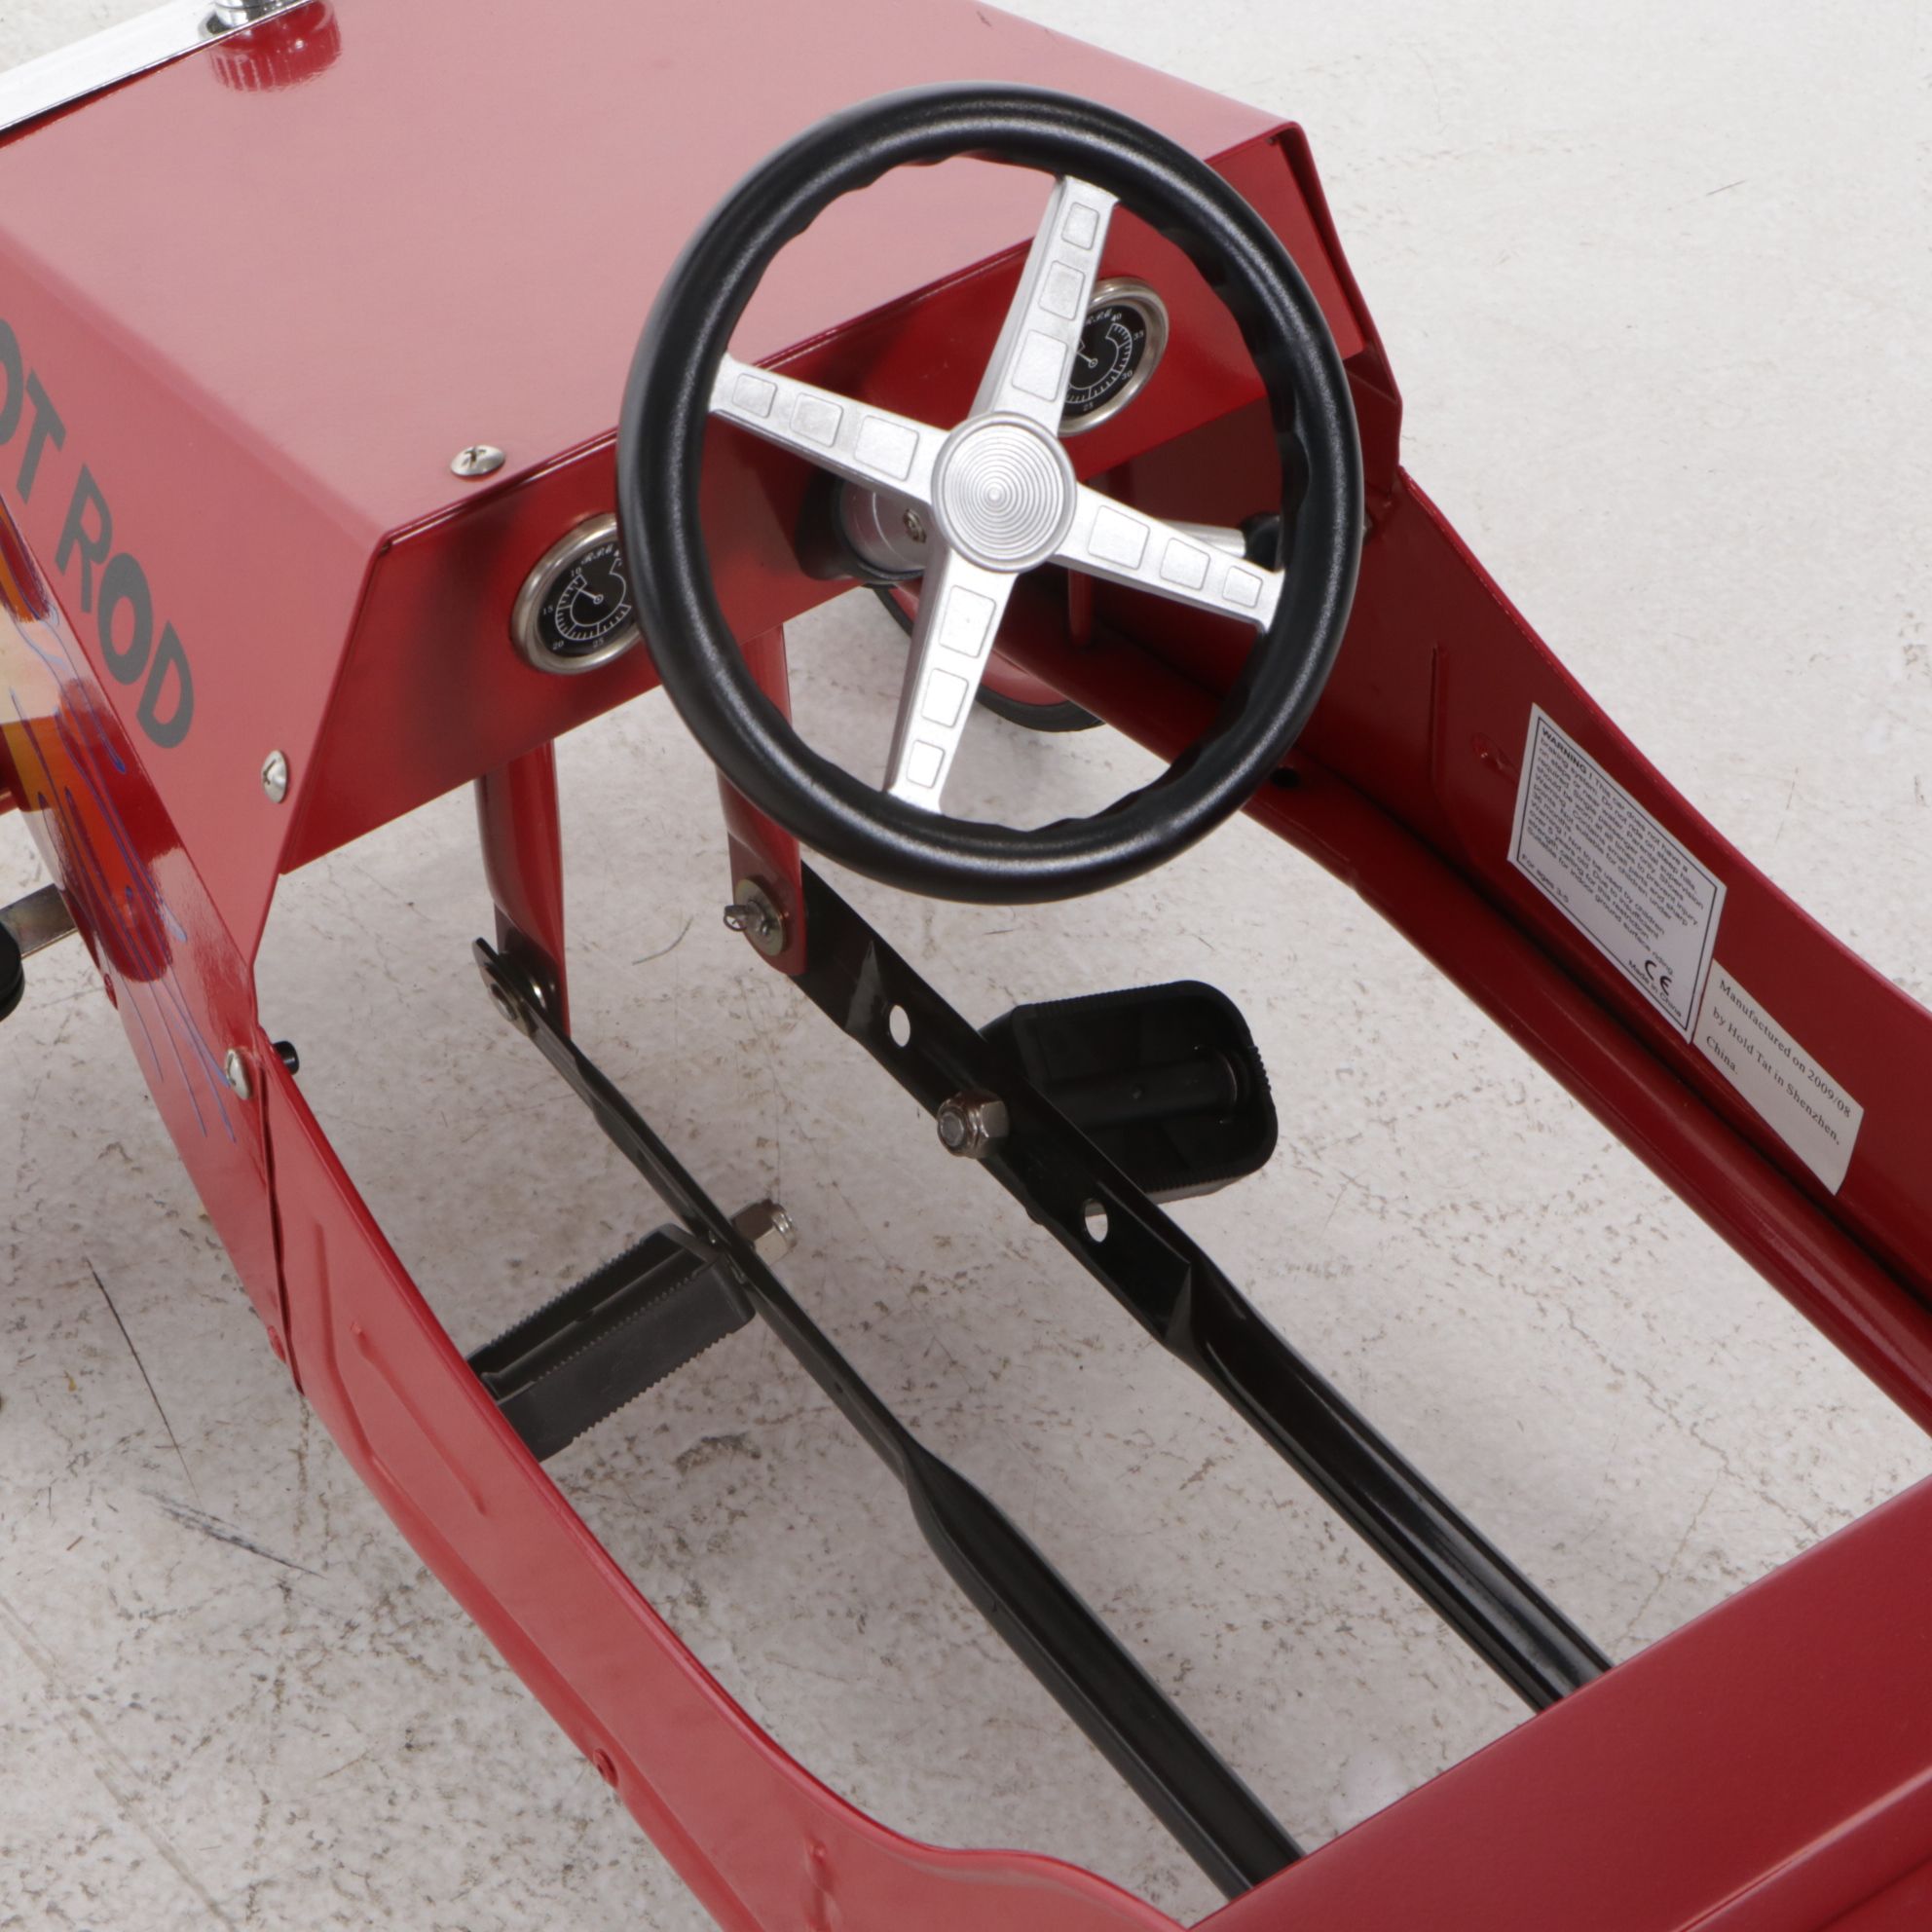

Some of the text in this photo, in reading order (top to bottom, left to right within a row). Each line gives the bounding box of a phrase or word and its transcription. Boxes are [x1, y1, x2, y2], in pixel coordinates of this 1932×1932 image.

[1122, 371, 1133, 381] 30
[571, 567, 581, 576] 10
[55, 463, 194, 748] ROD
[553, 641, 564, 650] 20
[1542, 726, 1587, 774] WARNING
[1595, 777, 1611, 799] This
[1612, 797, 1625, 810] car
[1626, 810, 1646, 832] does
[1647, 830, 1660, 846] not
[1614, 809, 1627, 825] not
[1605, 852, 1616, 866] for
[1626, 830, 1658, 866] Parental
[1649, 886, 1665, 904] and
[1628, 959, 1650, 985] Made
[1659, 991, 1682, 1018] China
[1644, 959, 1672, 996] CE
[1712, 1006, 1726, 1026] by
[1728, 1022, 1754, 1055] Hold
[1757, 1051, 1772, 1073] Tat
[1773, 1072, 1784, 1087] in
[1720, 980, 1850, 1118] Manufactured on 2009/08
